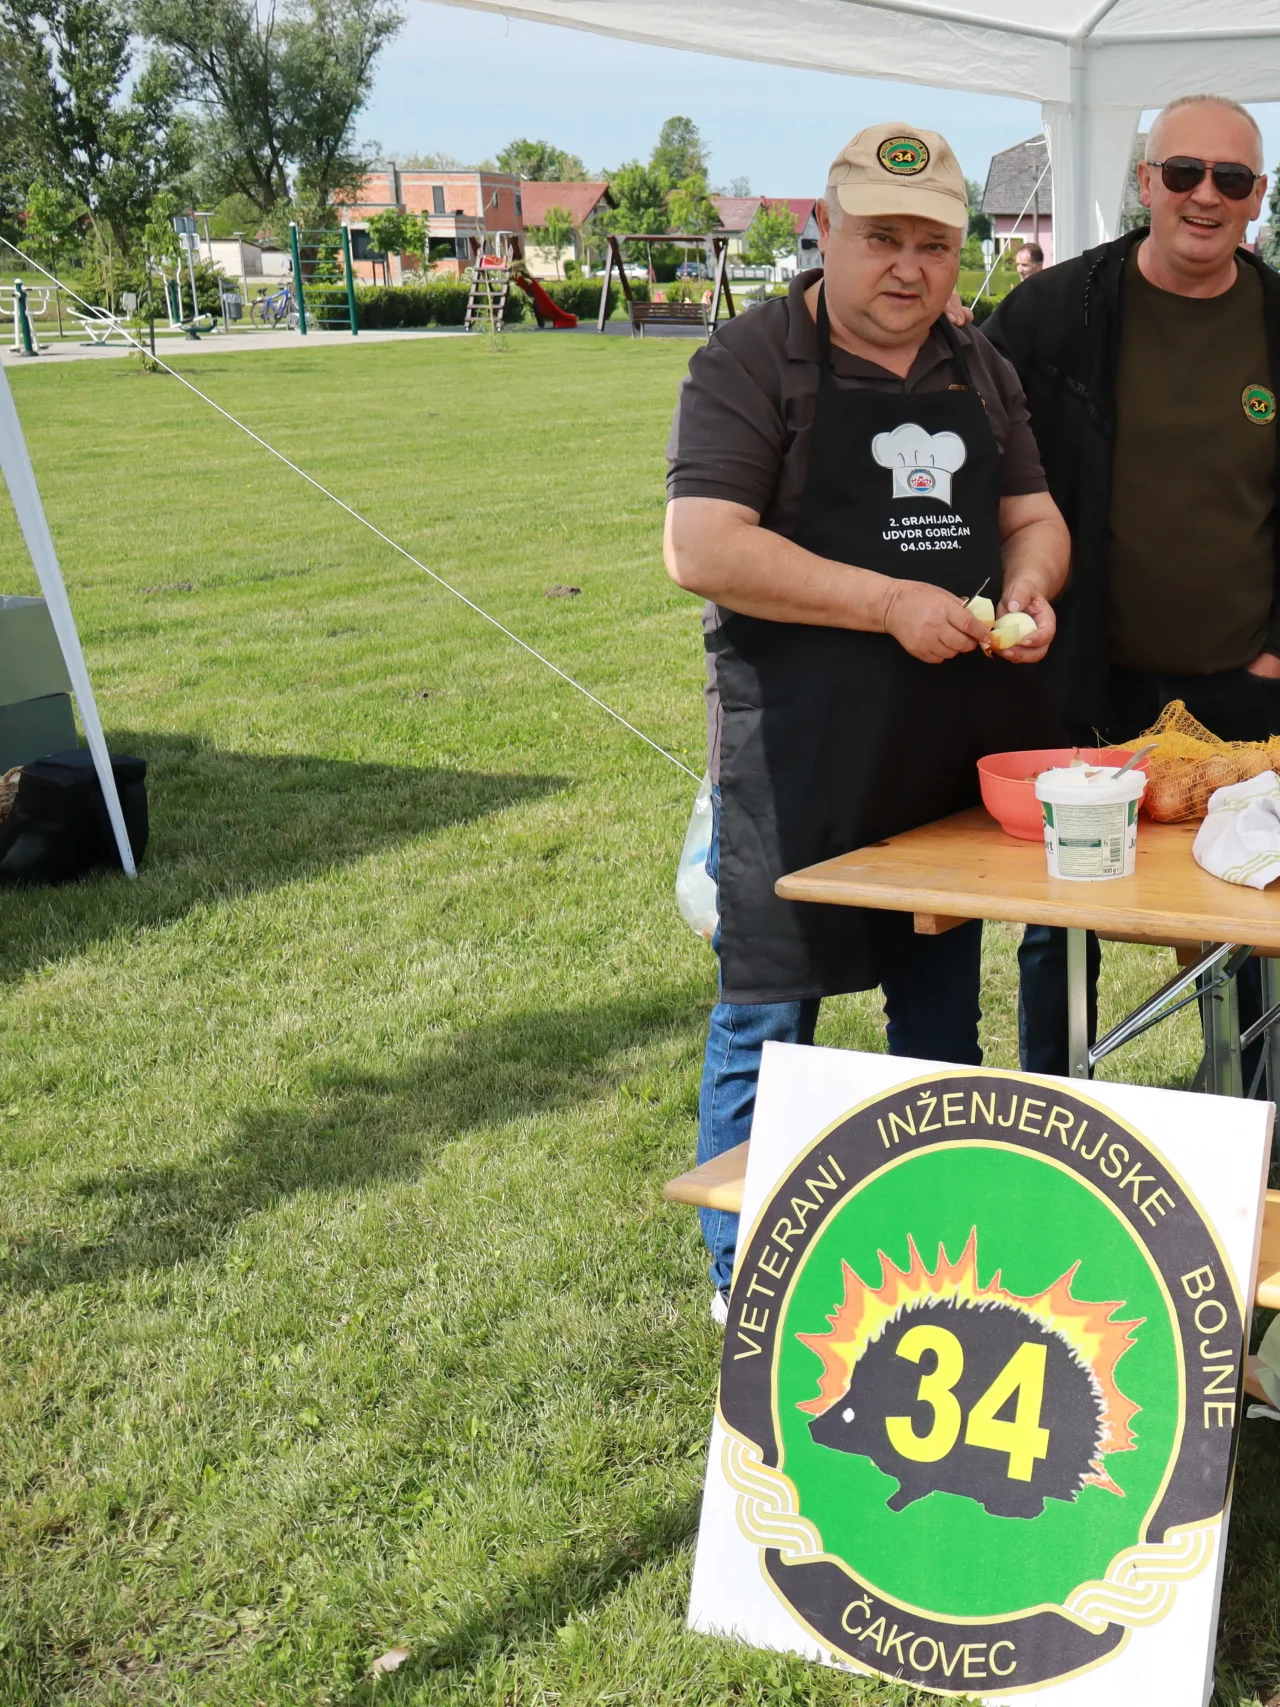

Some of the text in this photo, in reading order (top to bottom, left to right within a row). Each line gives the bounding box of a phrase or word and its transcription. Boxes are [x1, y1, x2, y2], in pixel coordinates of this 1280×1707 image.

[895, 152, 912, 162] 34
[1253, 401, 1265, 412] 34
[889, 514, 963, 527] 2. GRAHIJADA
[882, 525, 971, 540] UDVDR GORIČAN
[900, 540, 962, 552] 04.05.2024.
[733, 1090, 1236, 1429] VETERANI INŽENJERIJSKE BOJNE
[885, 1323, 1051, 1483] 34
[841, 1593, 1017, 1678] ČAKOVEC
